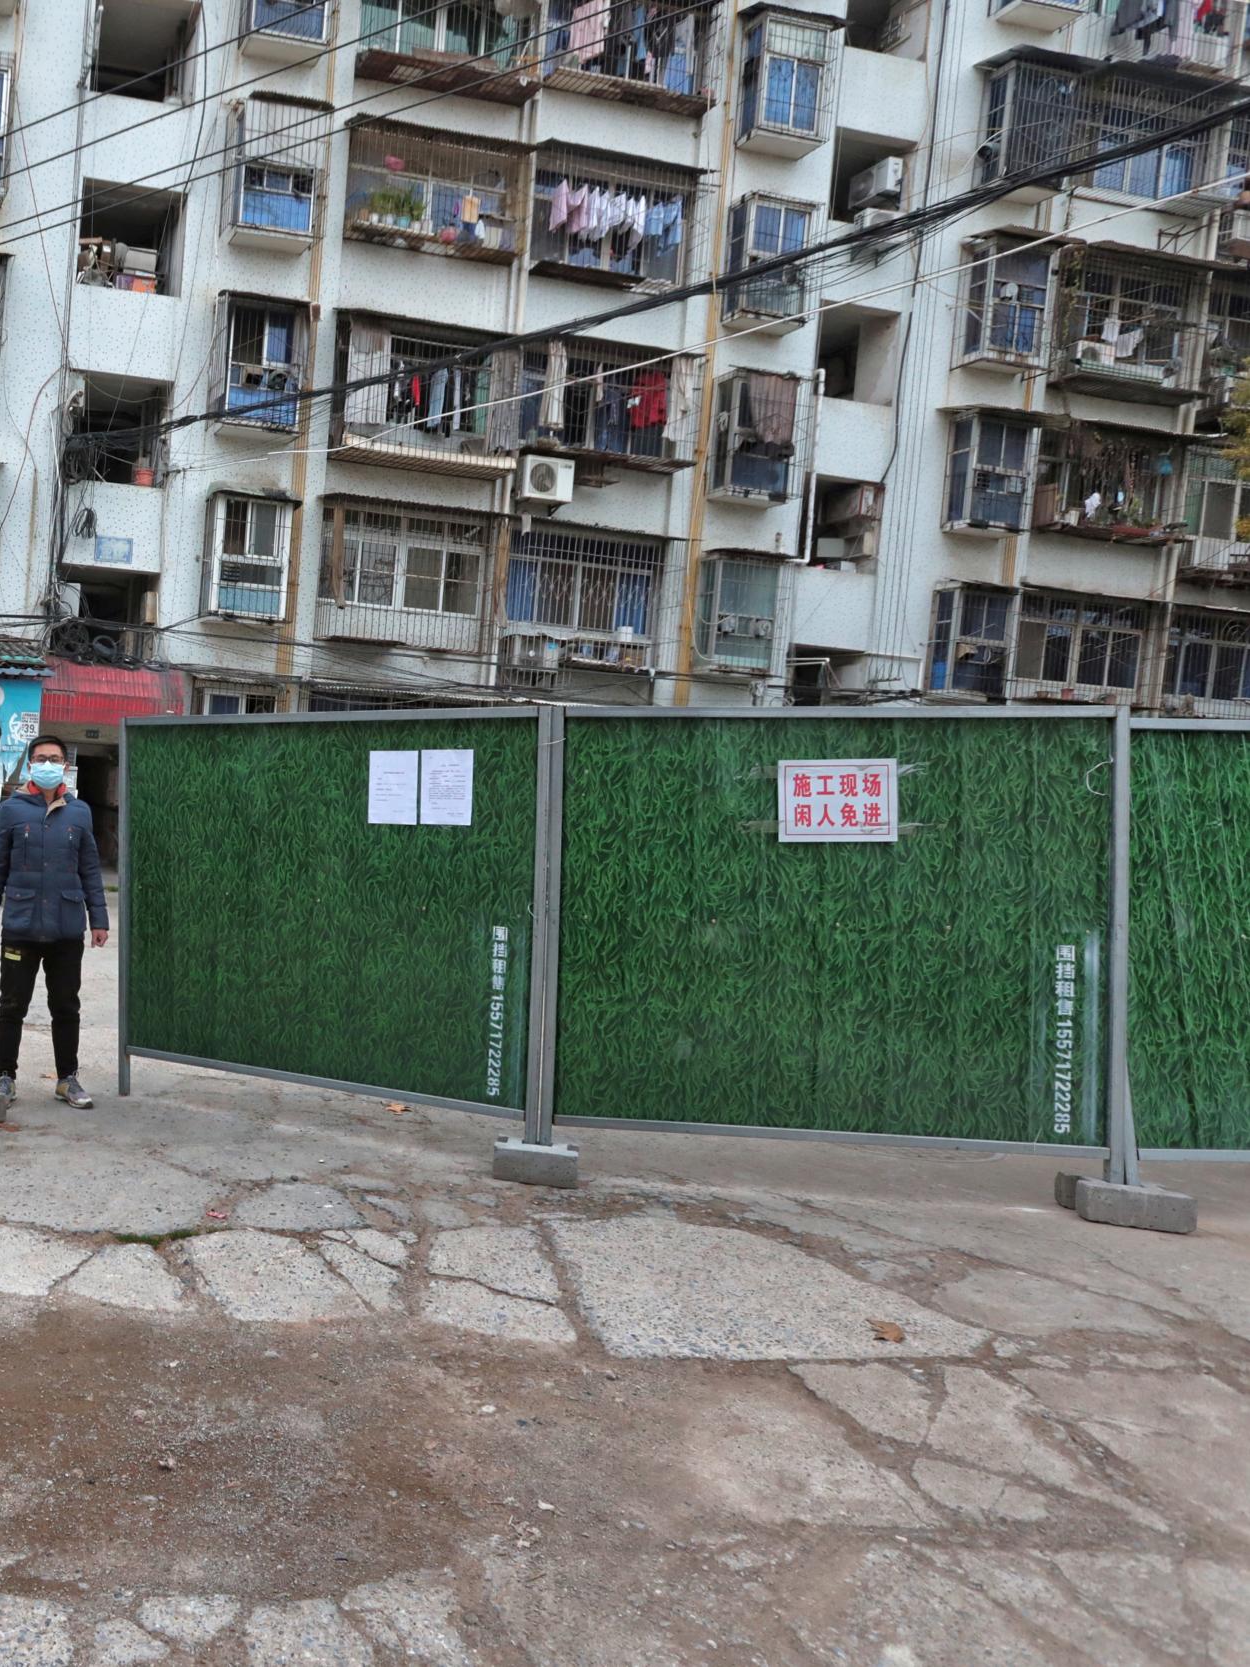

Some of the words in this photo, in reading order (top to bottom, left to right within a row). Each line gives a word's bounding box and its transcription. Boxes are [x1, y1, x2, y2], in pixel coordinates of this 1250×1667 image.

[792, 773, 882, 798] 施工现场
[794, 802, 882, 828] 闲人免进
[1055, 945, 1076, 1016] 围挡租售
[486, 995, 504, 1097] 15571722285
[1053, 1019, 1075, 1134] 15571722285
